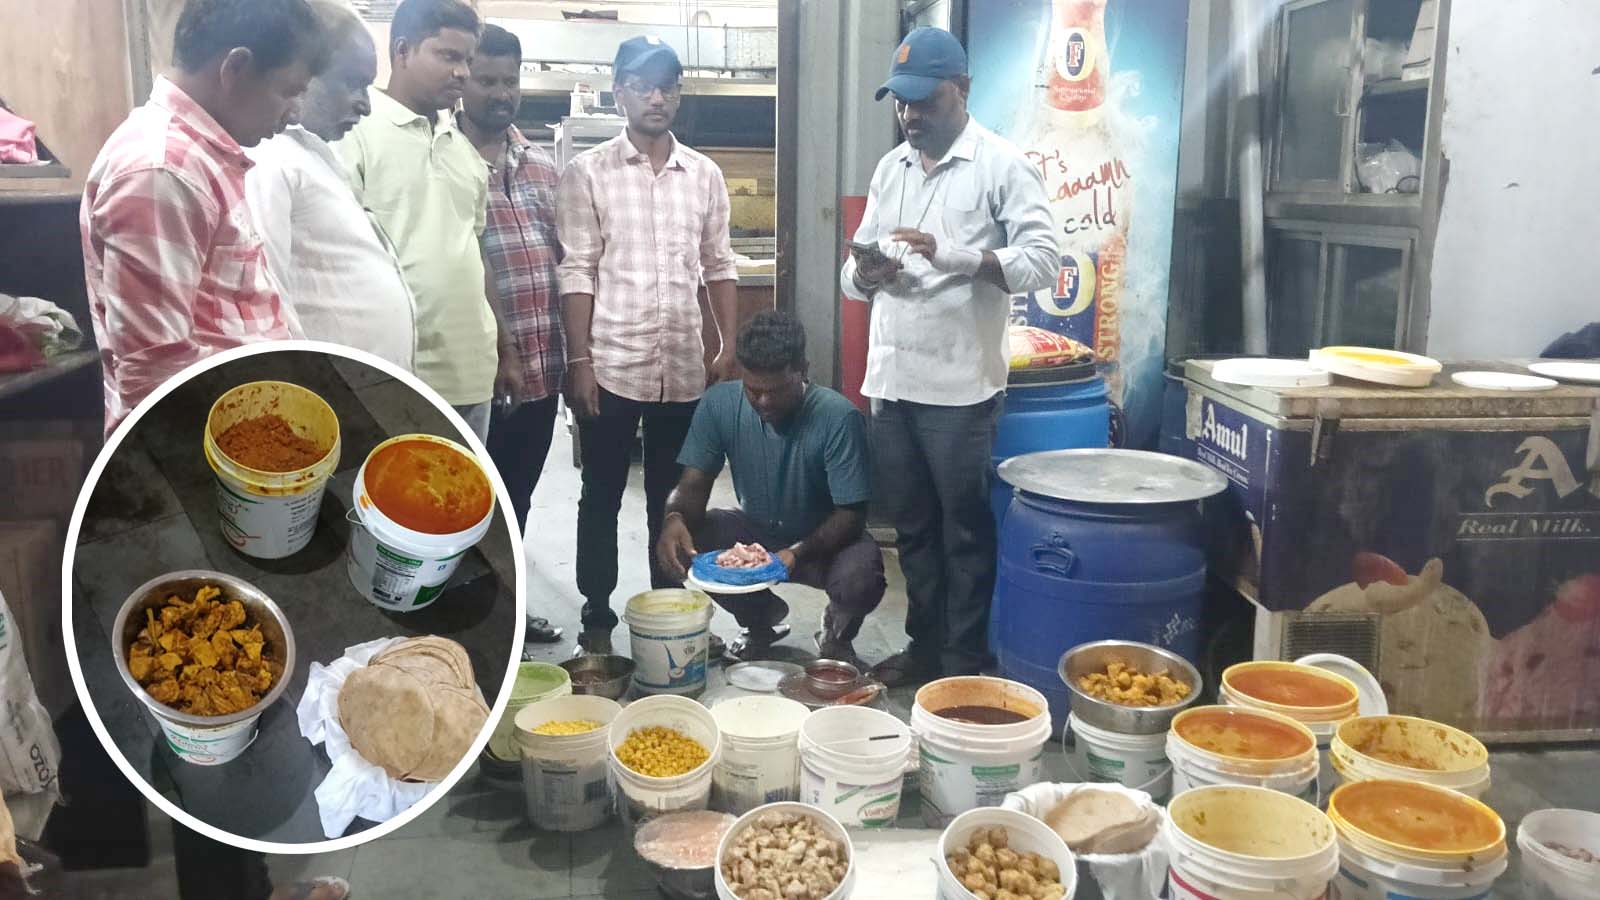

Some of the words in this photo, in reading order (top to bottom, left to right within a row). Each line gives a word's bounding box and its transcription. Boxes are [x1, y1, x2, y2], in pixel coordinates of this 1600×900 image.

[1067, 41, 1084, 68] F
[1063, 186, 1117, 234] cold
[1053, 265, 1079, 299] F
[1096, 258, 1121, 359] STRONG
[1202, 402, 1248, 461] Amul
[1484, 435, 1584, 508] A
[1457, 518, 1519, 536] Real
